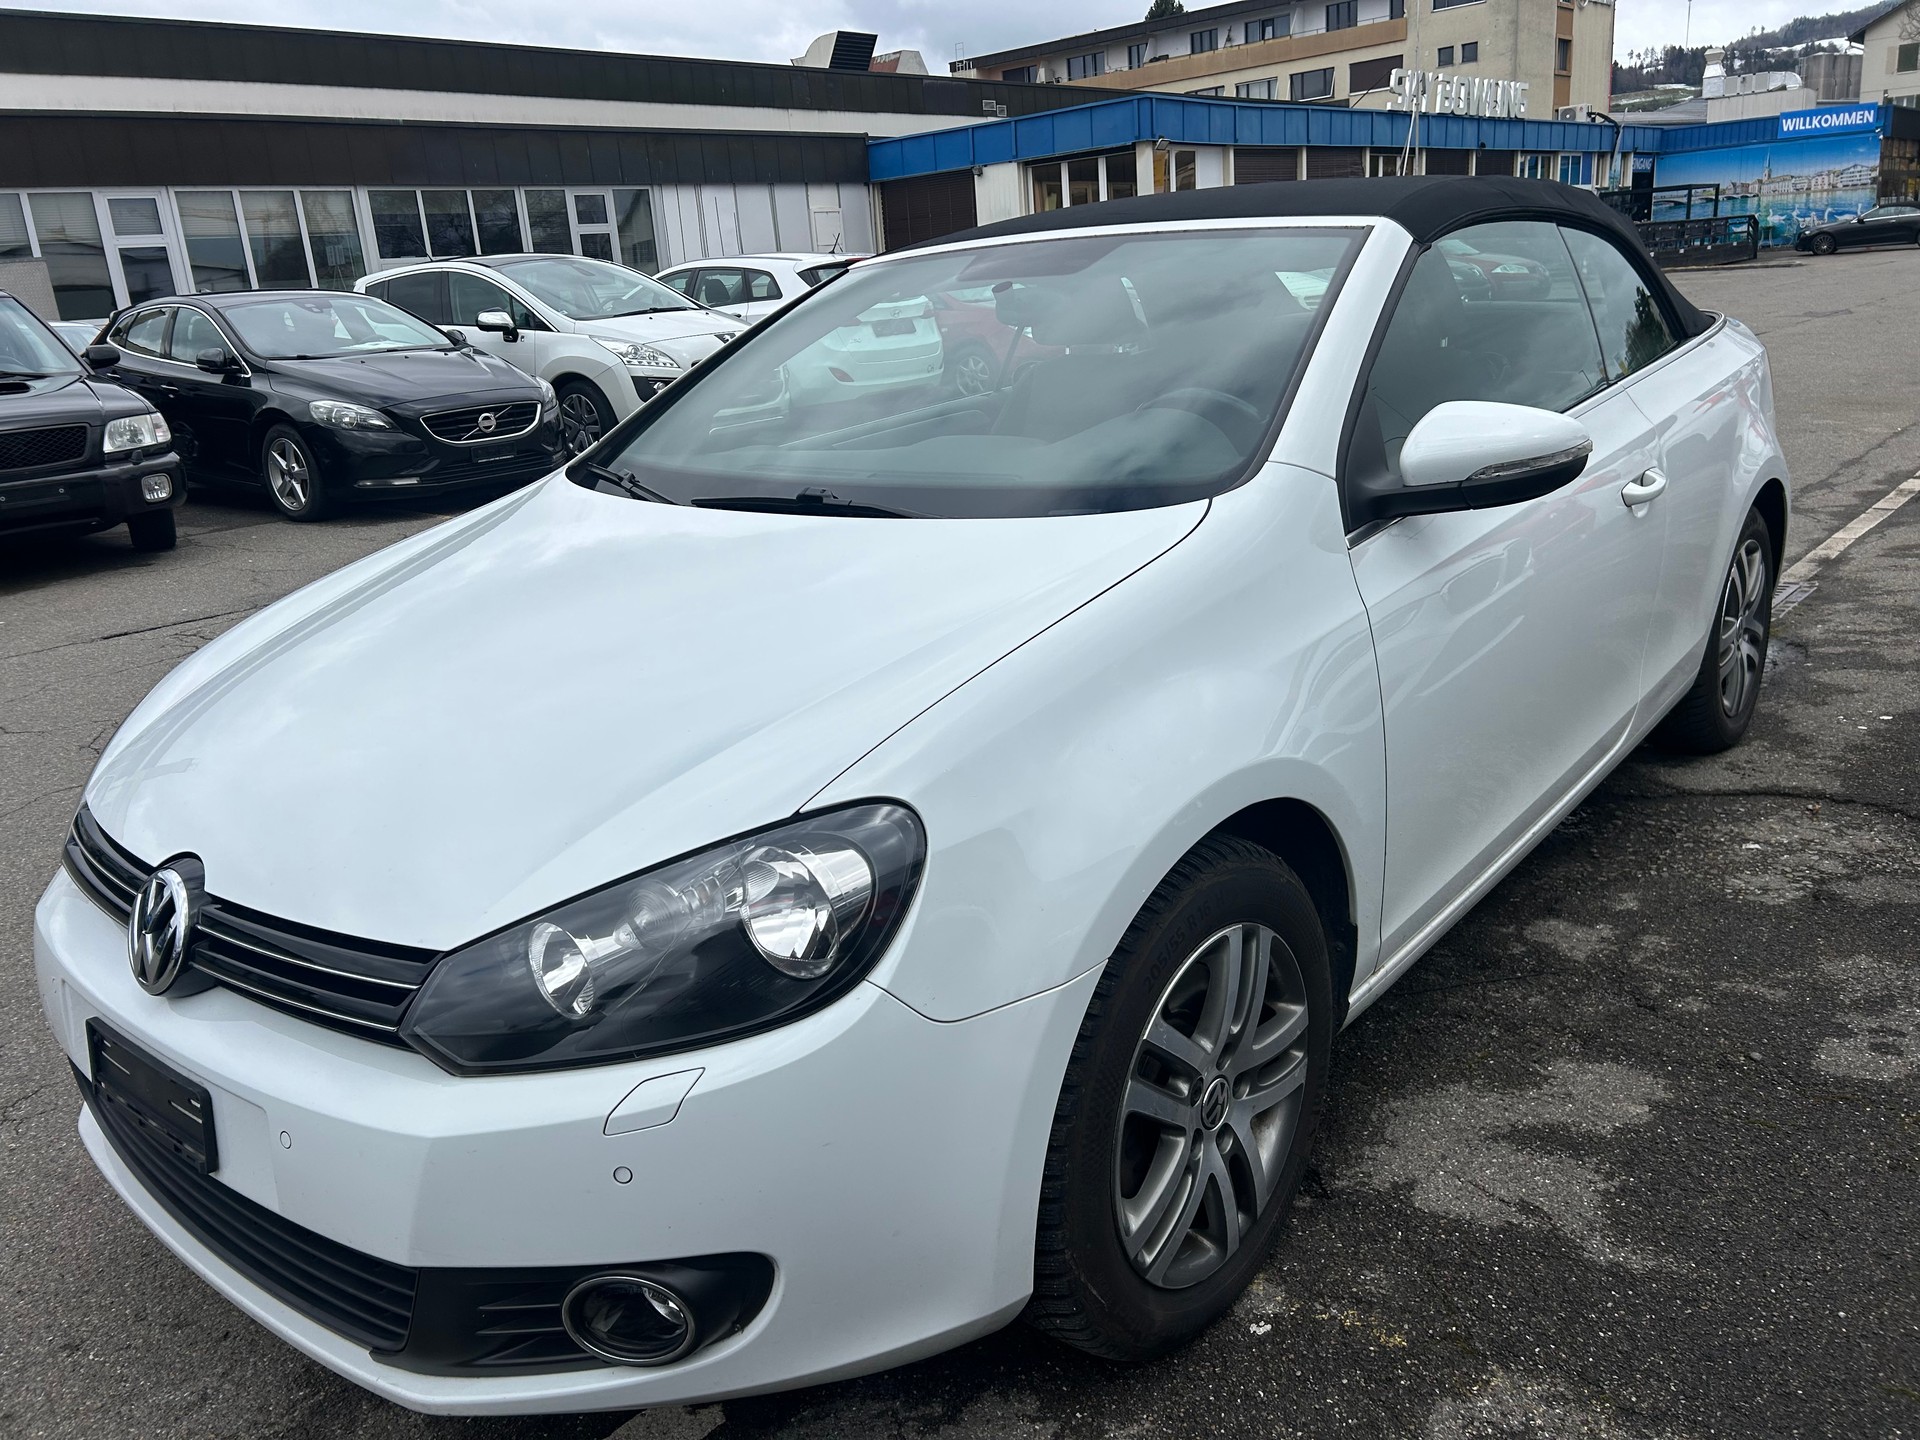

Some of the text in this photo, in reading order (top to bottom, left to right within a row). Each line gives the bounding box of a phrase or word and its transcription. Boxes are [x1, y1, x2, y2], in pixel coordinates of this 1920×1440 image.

[1436, 73, 1529, 118] BOWLING
[1782, 110, 1874, 132] WILLKOMMEN
[1144, 927, 1186, 993] 205/55
